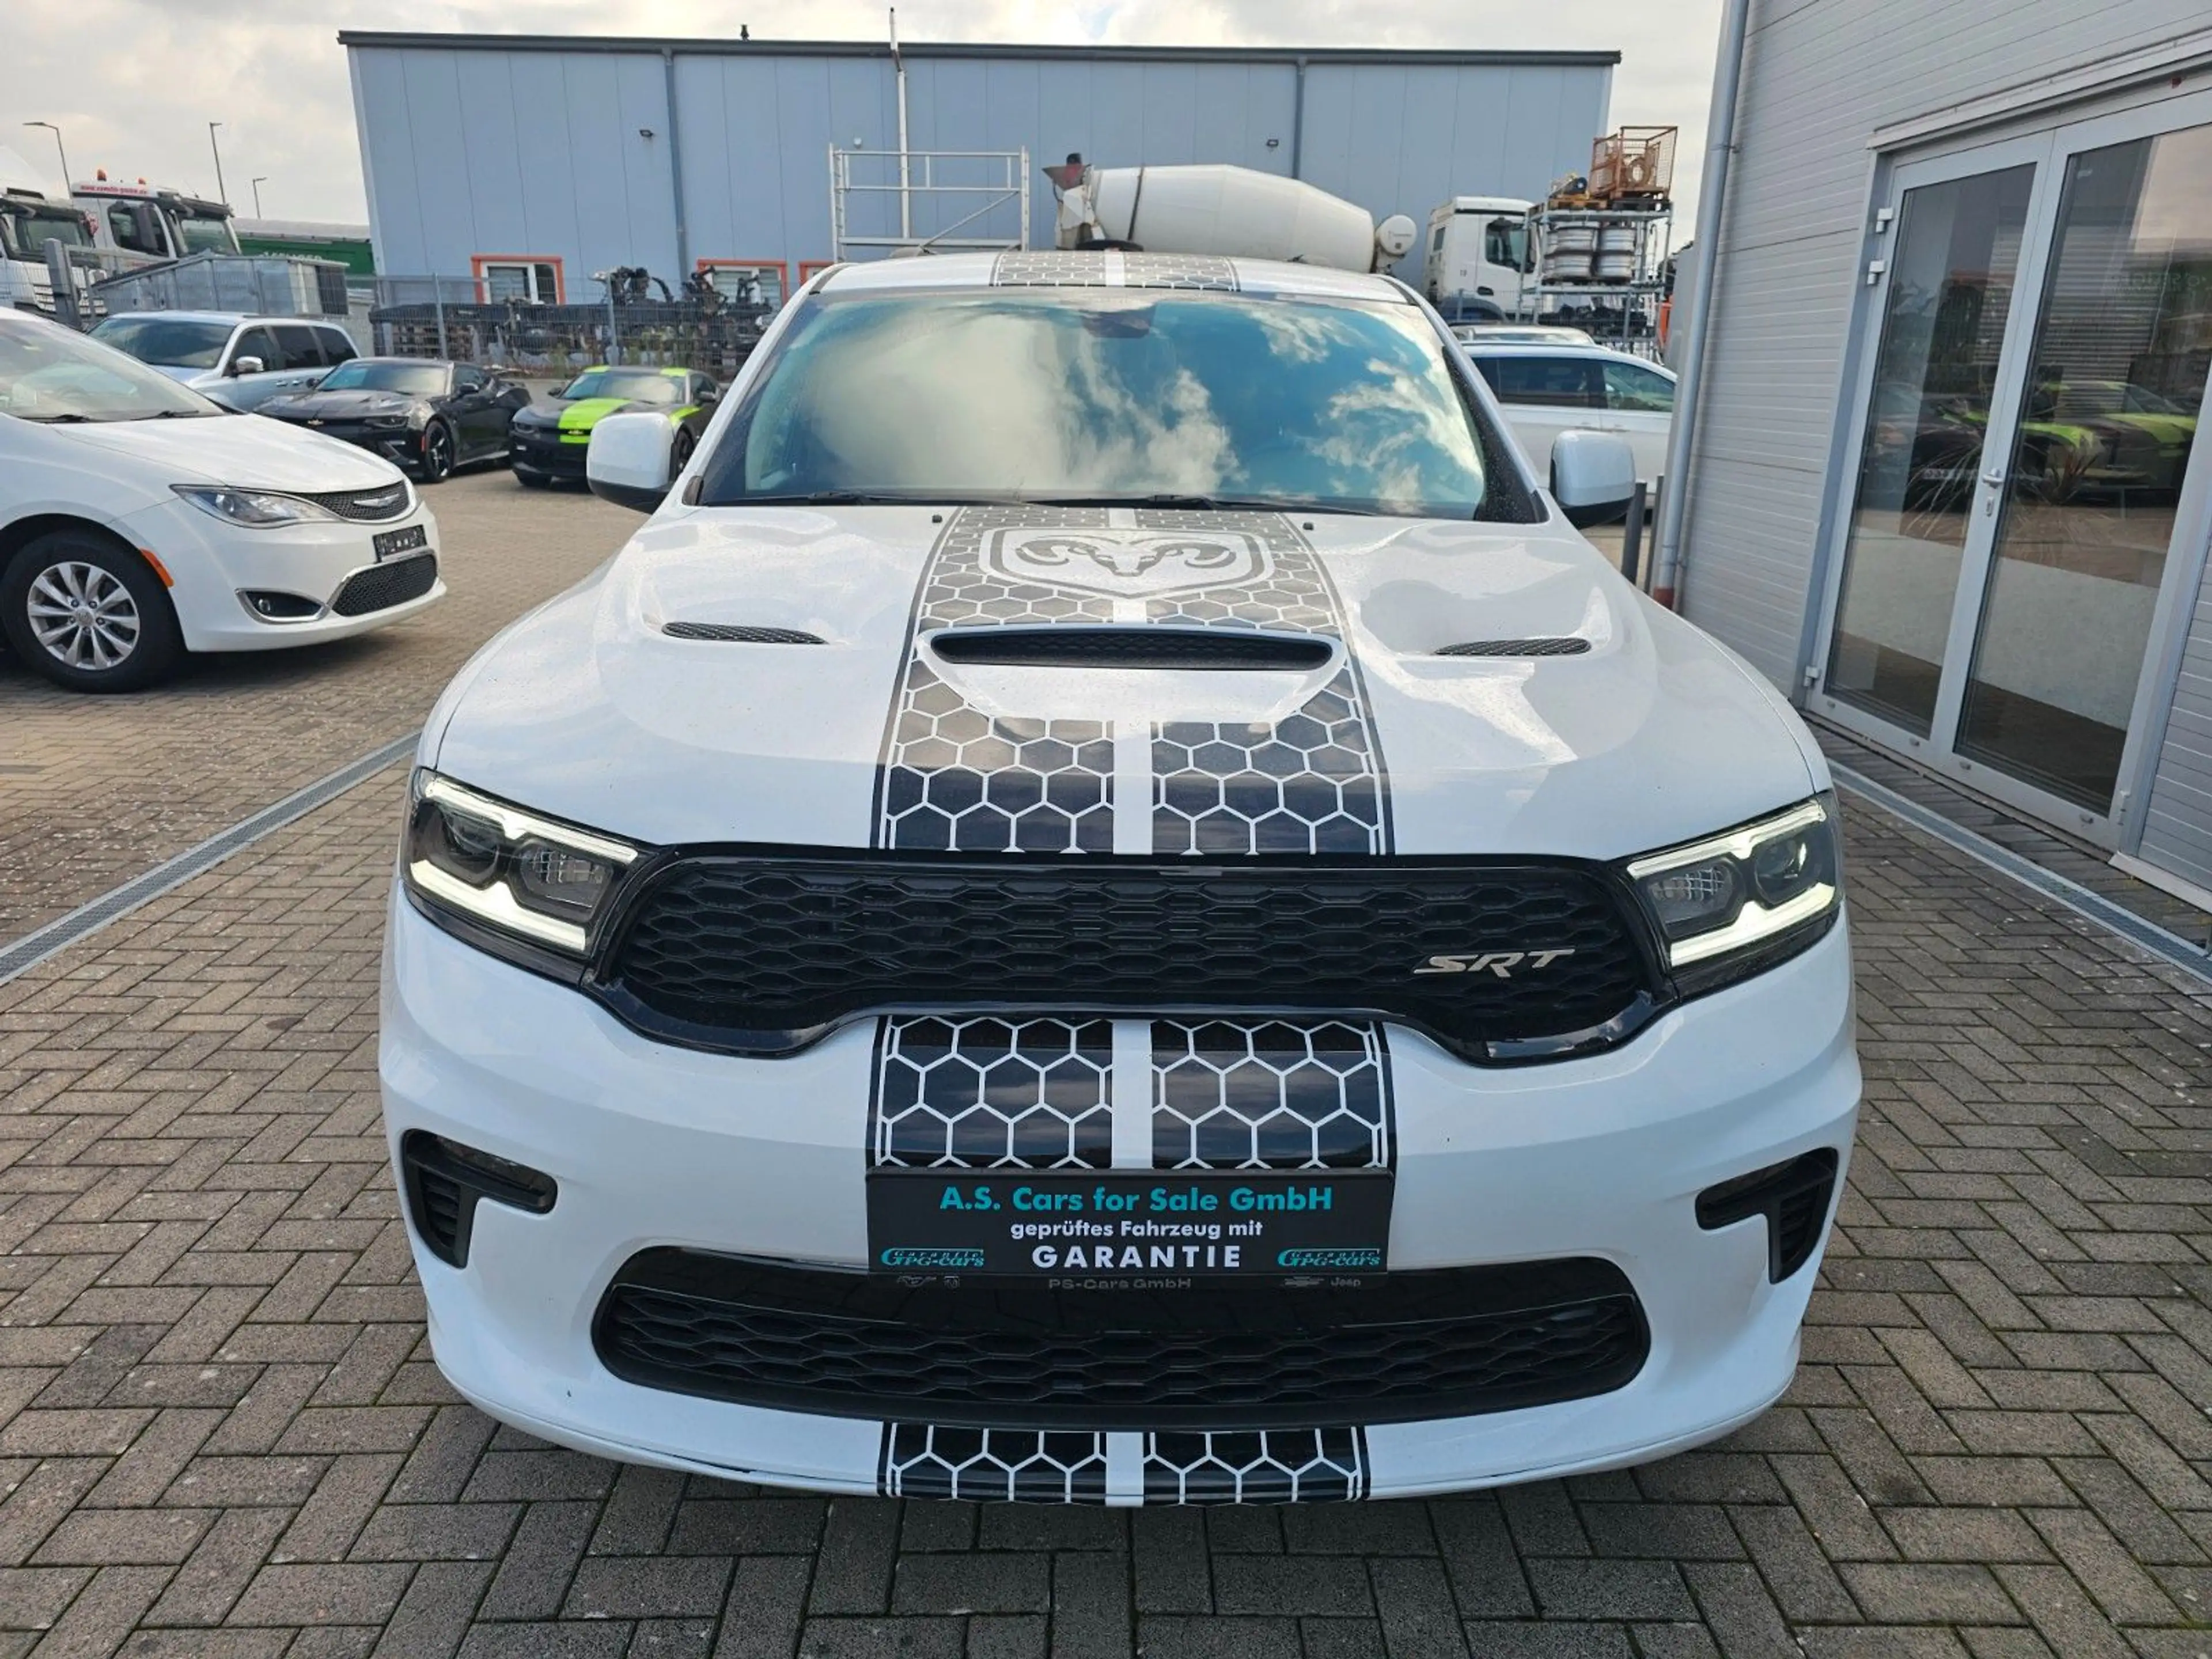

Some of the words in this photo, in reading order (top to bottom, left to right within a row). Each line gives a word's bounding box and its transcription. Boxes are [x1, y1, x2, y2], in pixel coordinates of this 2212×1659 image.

[1413, 948, 1576, 978] SRT
[940, 1186, 1001, 1210] A.S.
[1013, 1186, 1084, 1211] Cars
[1093, 1186, 1140, 1211] for
[1149, 1187, 1218, 1211] Sale
[1230, 1186, 1333, 1211] GmbH
[1010, 1220, 1114, 1240] geprüftes
[1120, 1219, 1221, 1240] Fahrzeug
[1228, 1220, 1263, 1237] mit
[1032, 1245, 1241, 1268] GARANTIE
[1048, 1278, 1129, 1290] PS-Cars
[1133, 1278, 1192, 1289] GmbH
[1330, 1277, 1362, 1287] Jeep
